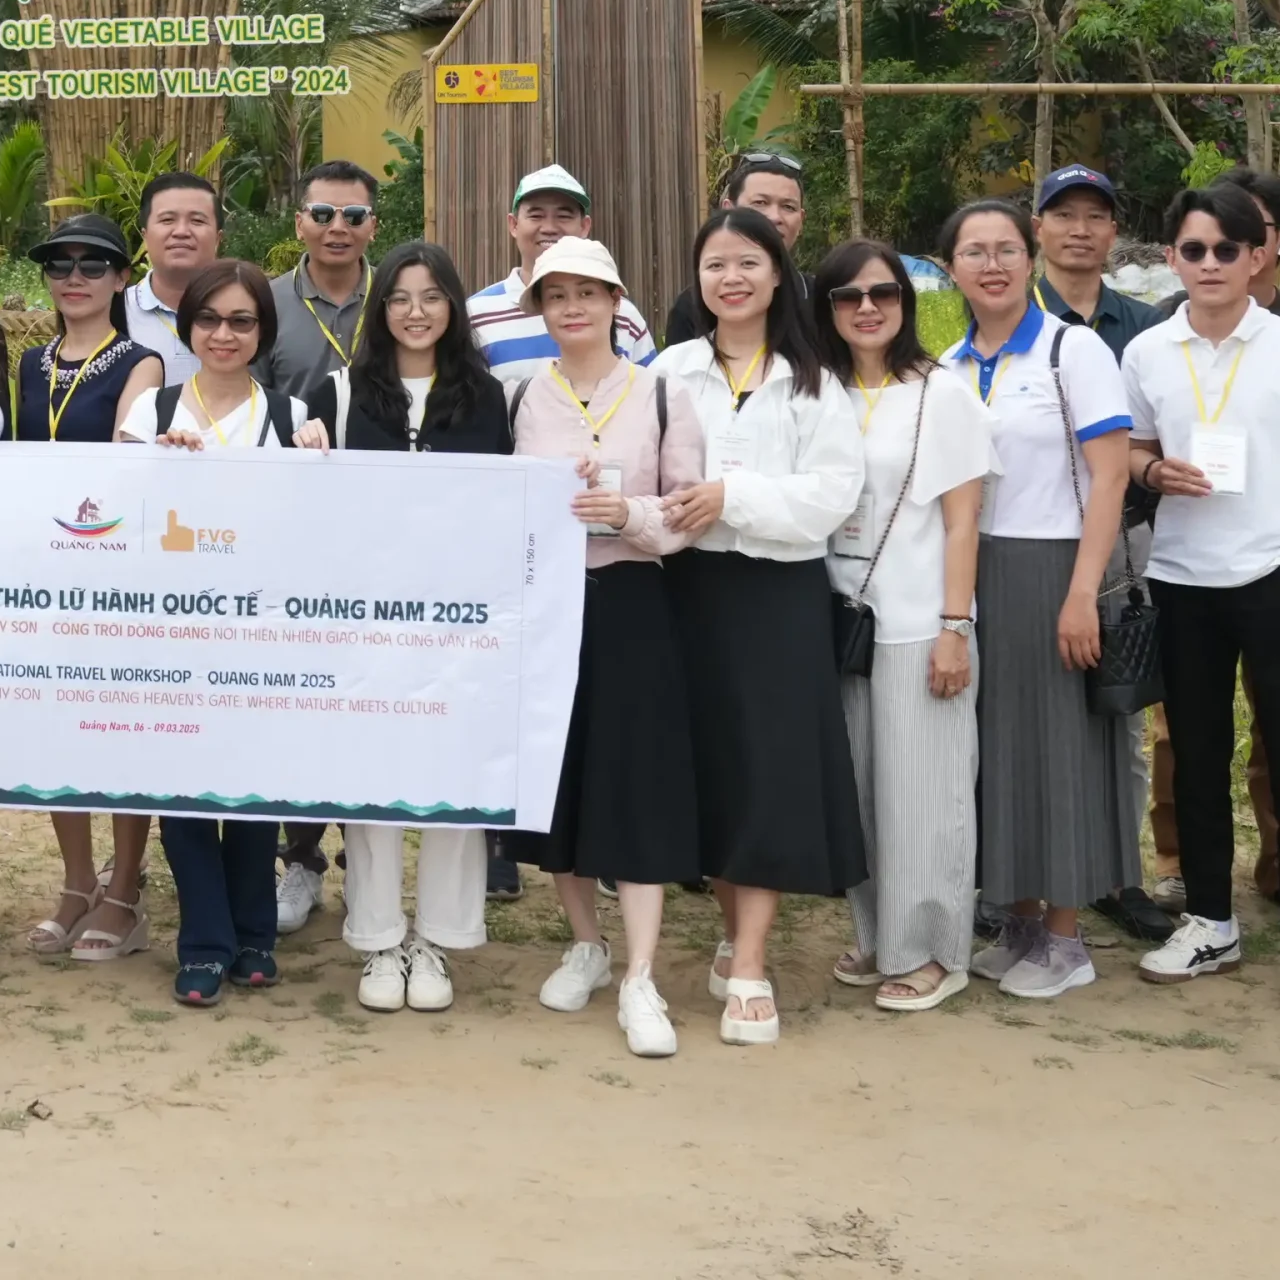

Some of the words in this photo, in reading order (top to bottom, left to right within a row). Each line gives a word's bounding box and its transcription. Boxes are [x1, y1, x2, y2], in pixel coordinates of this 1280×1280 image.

[63, 19, 207, 46] VEGETABLE
[218, 16, 323, 41] VILLAGE
[47, 71, 155, 96] TOURISM
[163, 70, 268, 94] VILLAGE
[295, 69, 348, 93] 2024
[197, 528, 237, 544] FVG
[528, 533, 535, 547] cm
[99, 542, 127, 552] NAM
[197, 543, 236, 554] TRAVEL
[526, 548, 535, 564] 150
[525, 574, 534, 586] 70
[59, 586, 86, 611] LỮ
[92, 587, 155, 614] HÀNH
[162, 587, 228, 616] QUỐC
[233, 589, 263, 616] TẾ
[284, 593, 366, 620] QUẢNG
[373, 600, 425, 622] NAM
[432, 601, 489, 624] 2025
[169, 625, 210, 640] GIANG
[326, 630, 359, 646] GIAO
[56, 665, 107, 682] TRAVEL
[110, 667, 192, 684] WORKSHOP
[208, 671, 259, 686] QUANG
[263, 672, 296, 687] NAM
[300, 673, 336, 689] 2025
[14, 687, 41, 701] SON
[56, 688, 95, 702] DONG
[99, 690, 140, 704] GIANG
[247, 695, 291, 710] WHERE
[295, 697, 345, 712] NATURE
[348, 699, 389, 714] MEETS
[393, 701, 448, 716] CULTURE
[109, 721, 131, 732] Nam,
[133, 722, 145, 732] 06
[153, 722, 200, 734] 09.03.2025
